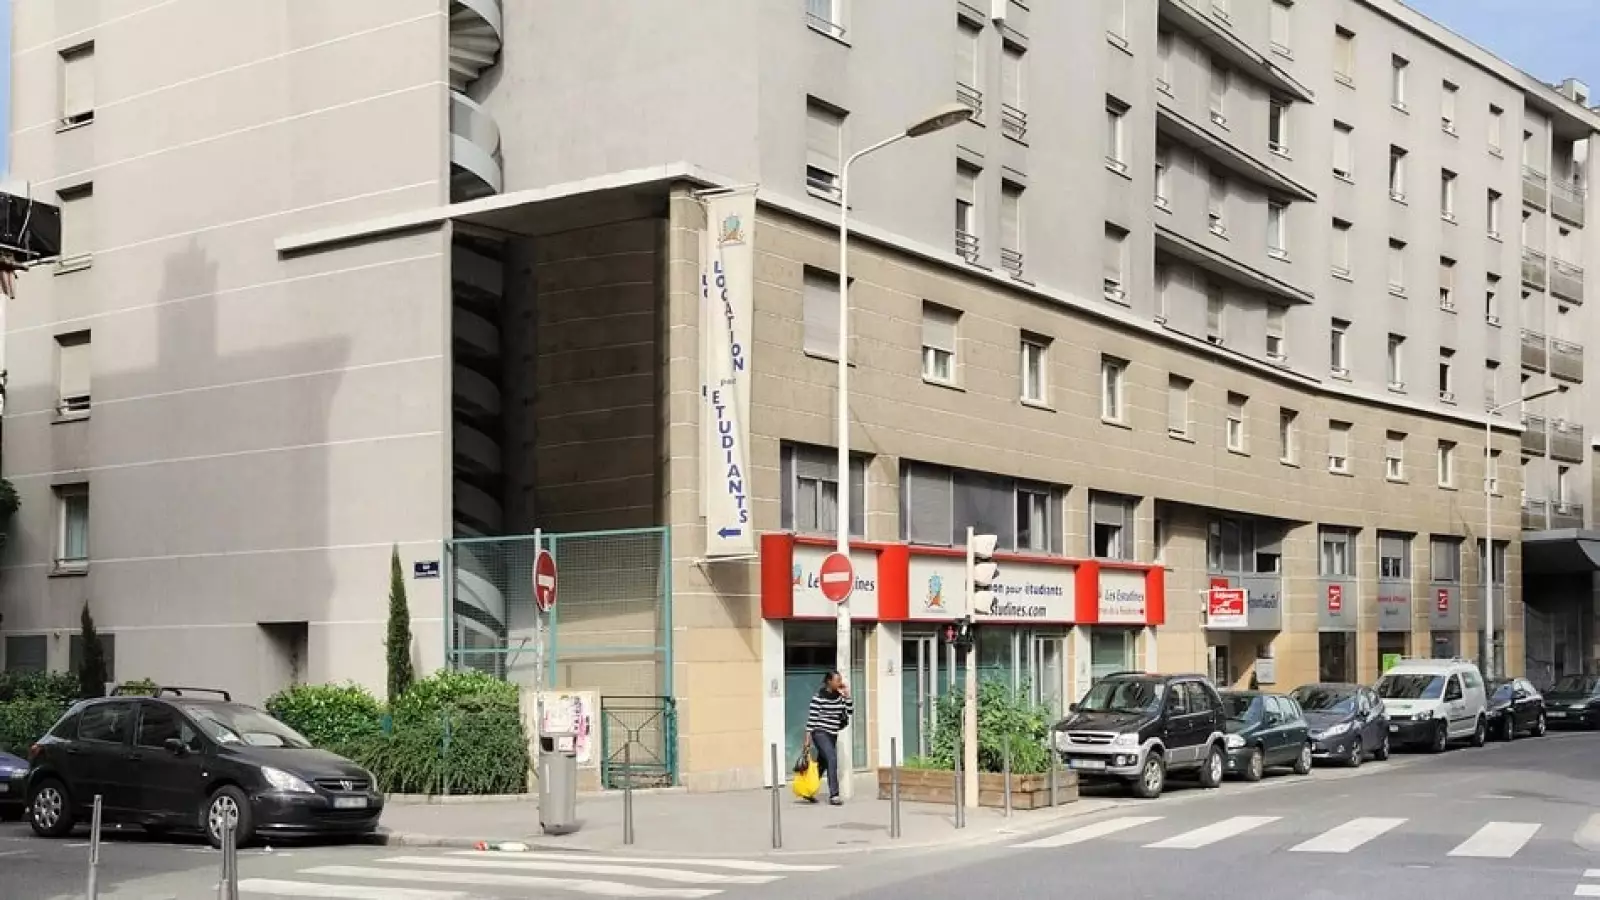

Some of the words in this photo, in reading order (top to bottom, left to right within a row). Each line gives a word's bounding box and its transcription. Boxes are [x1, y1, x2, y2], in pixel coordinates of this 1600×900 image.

[714, 261, 744, 370] LOCATION
[712, 390, 748, 524] ETUDIANTS
[808, 572, 820, 588] Le
